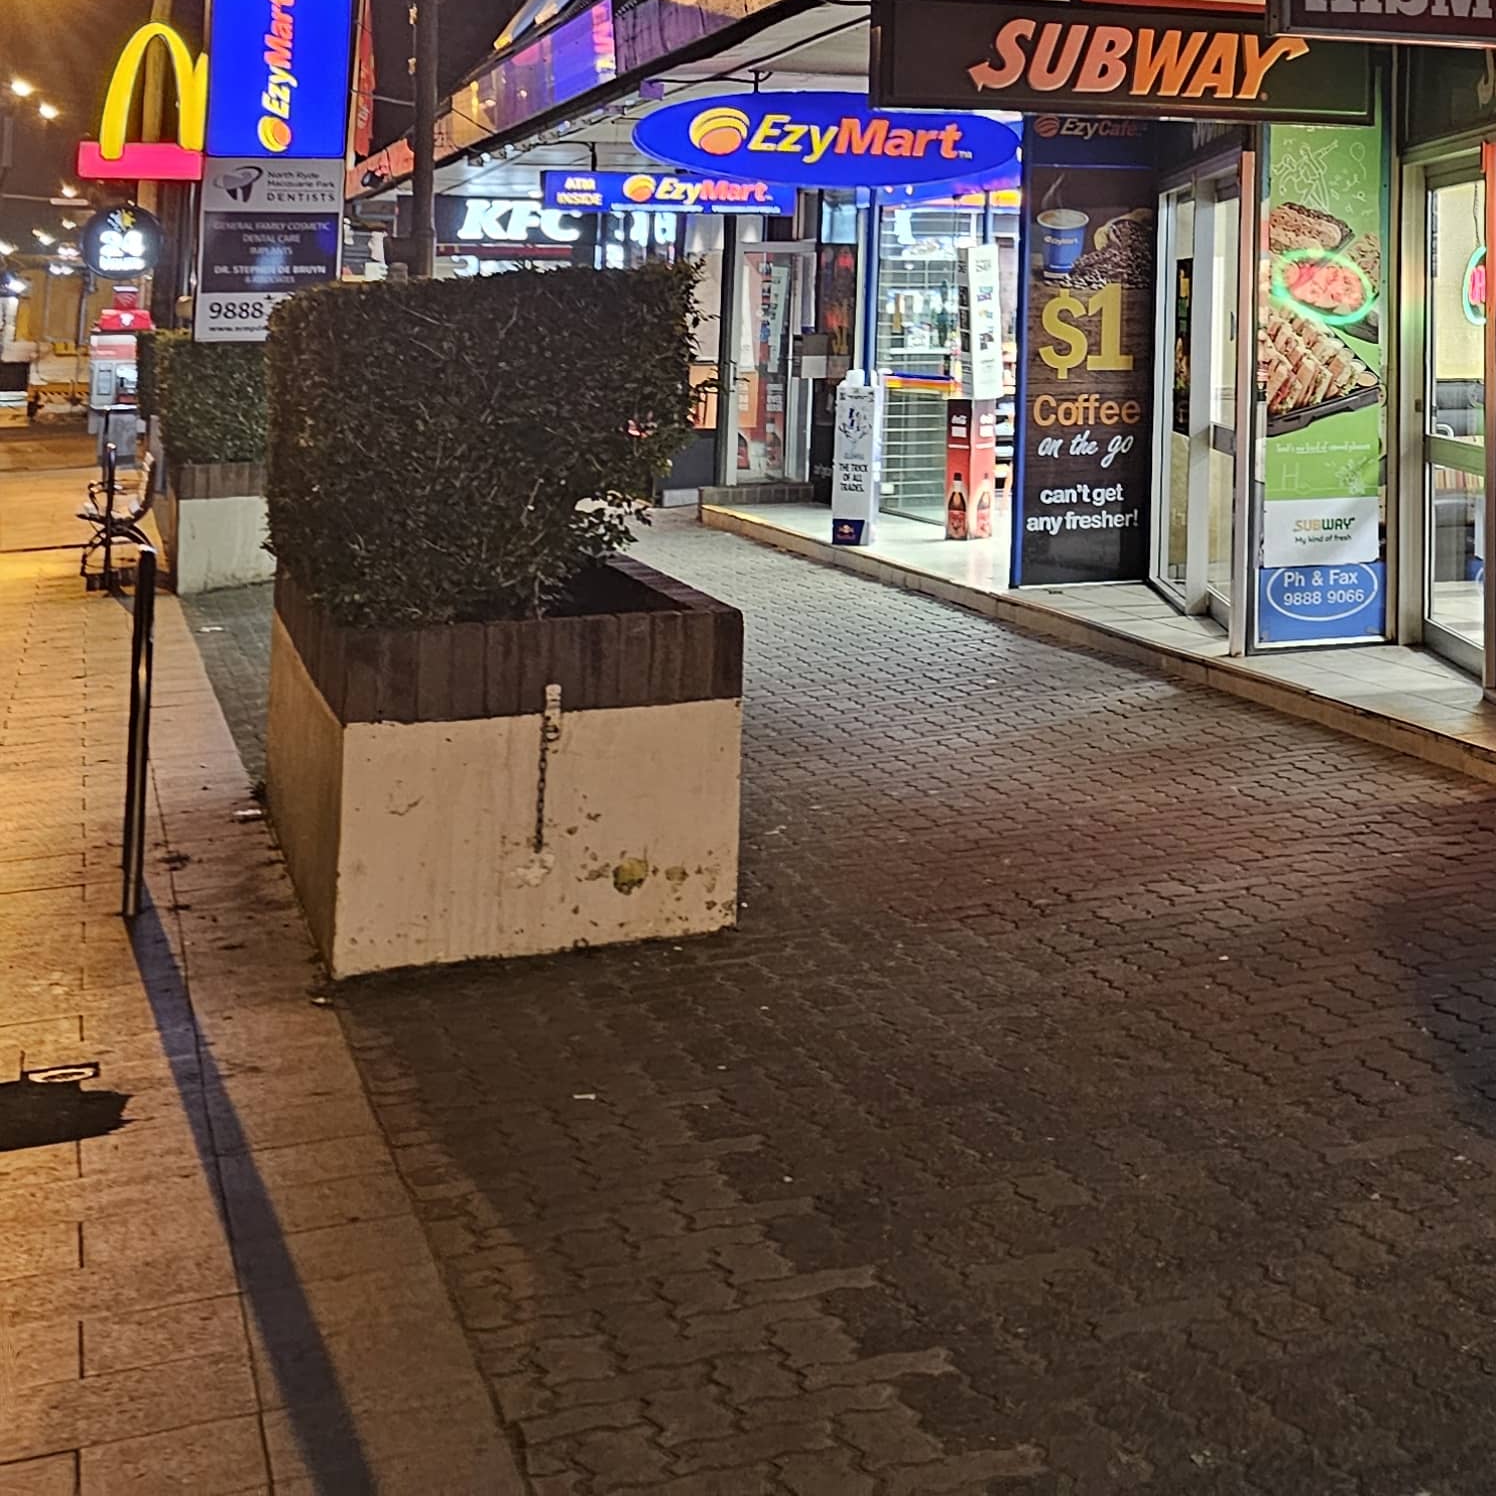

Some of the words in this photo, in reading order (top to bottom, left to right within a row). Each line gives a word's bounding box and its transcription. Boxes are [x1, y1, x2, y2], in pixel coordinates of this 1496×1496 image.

[967, 17, 1312, 101] SUBWAY
[746, 113, 963, 164] EzyMart
[563, 176, 596, 191] ATM
[655, 176, 768, 205] EzyMart
[266, 192, 336, 202] DENTISTS
[556, 190, 603, 206] INSIDE
[456, 198, 584, 242] KFC
[208, 302, 264, 320] 9888
[1038, 283, 1134, 380] $1
[1032, 392, 1141, 427] Coffee
[1037, 437, 1063, 457] on
[1069, 433, 1098, 456] the
[1101, 434, 1134, 468] go
[1040, 485, 1091, 505] can't
[1092, 484, 1124, 509] get
[1026, 513, 1063, 534] any
[1064, 508, 1140, 532] fresher!
[1293, 517, 1355, 532] SUBWAY
[1294, 536, 1307, 544] My
[1308, 535, 1323, 544] kind
[1324, 535, 1334, 543] of
[1333, 534, 1352, 542] fresh
[1283, 572, 1305, 587] Ph
[1311, 570, 1324, 586] &
[1328, 569, 1359, 585] Fax
[1283, 590, 1322, 606] 9888
[1327, 588, 1365, 605] 9066
